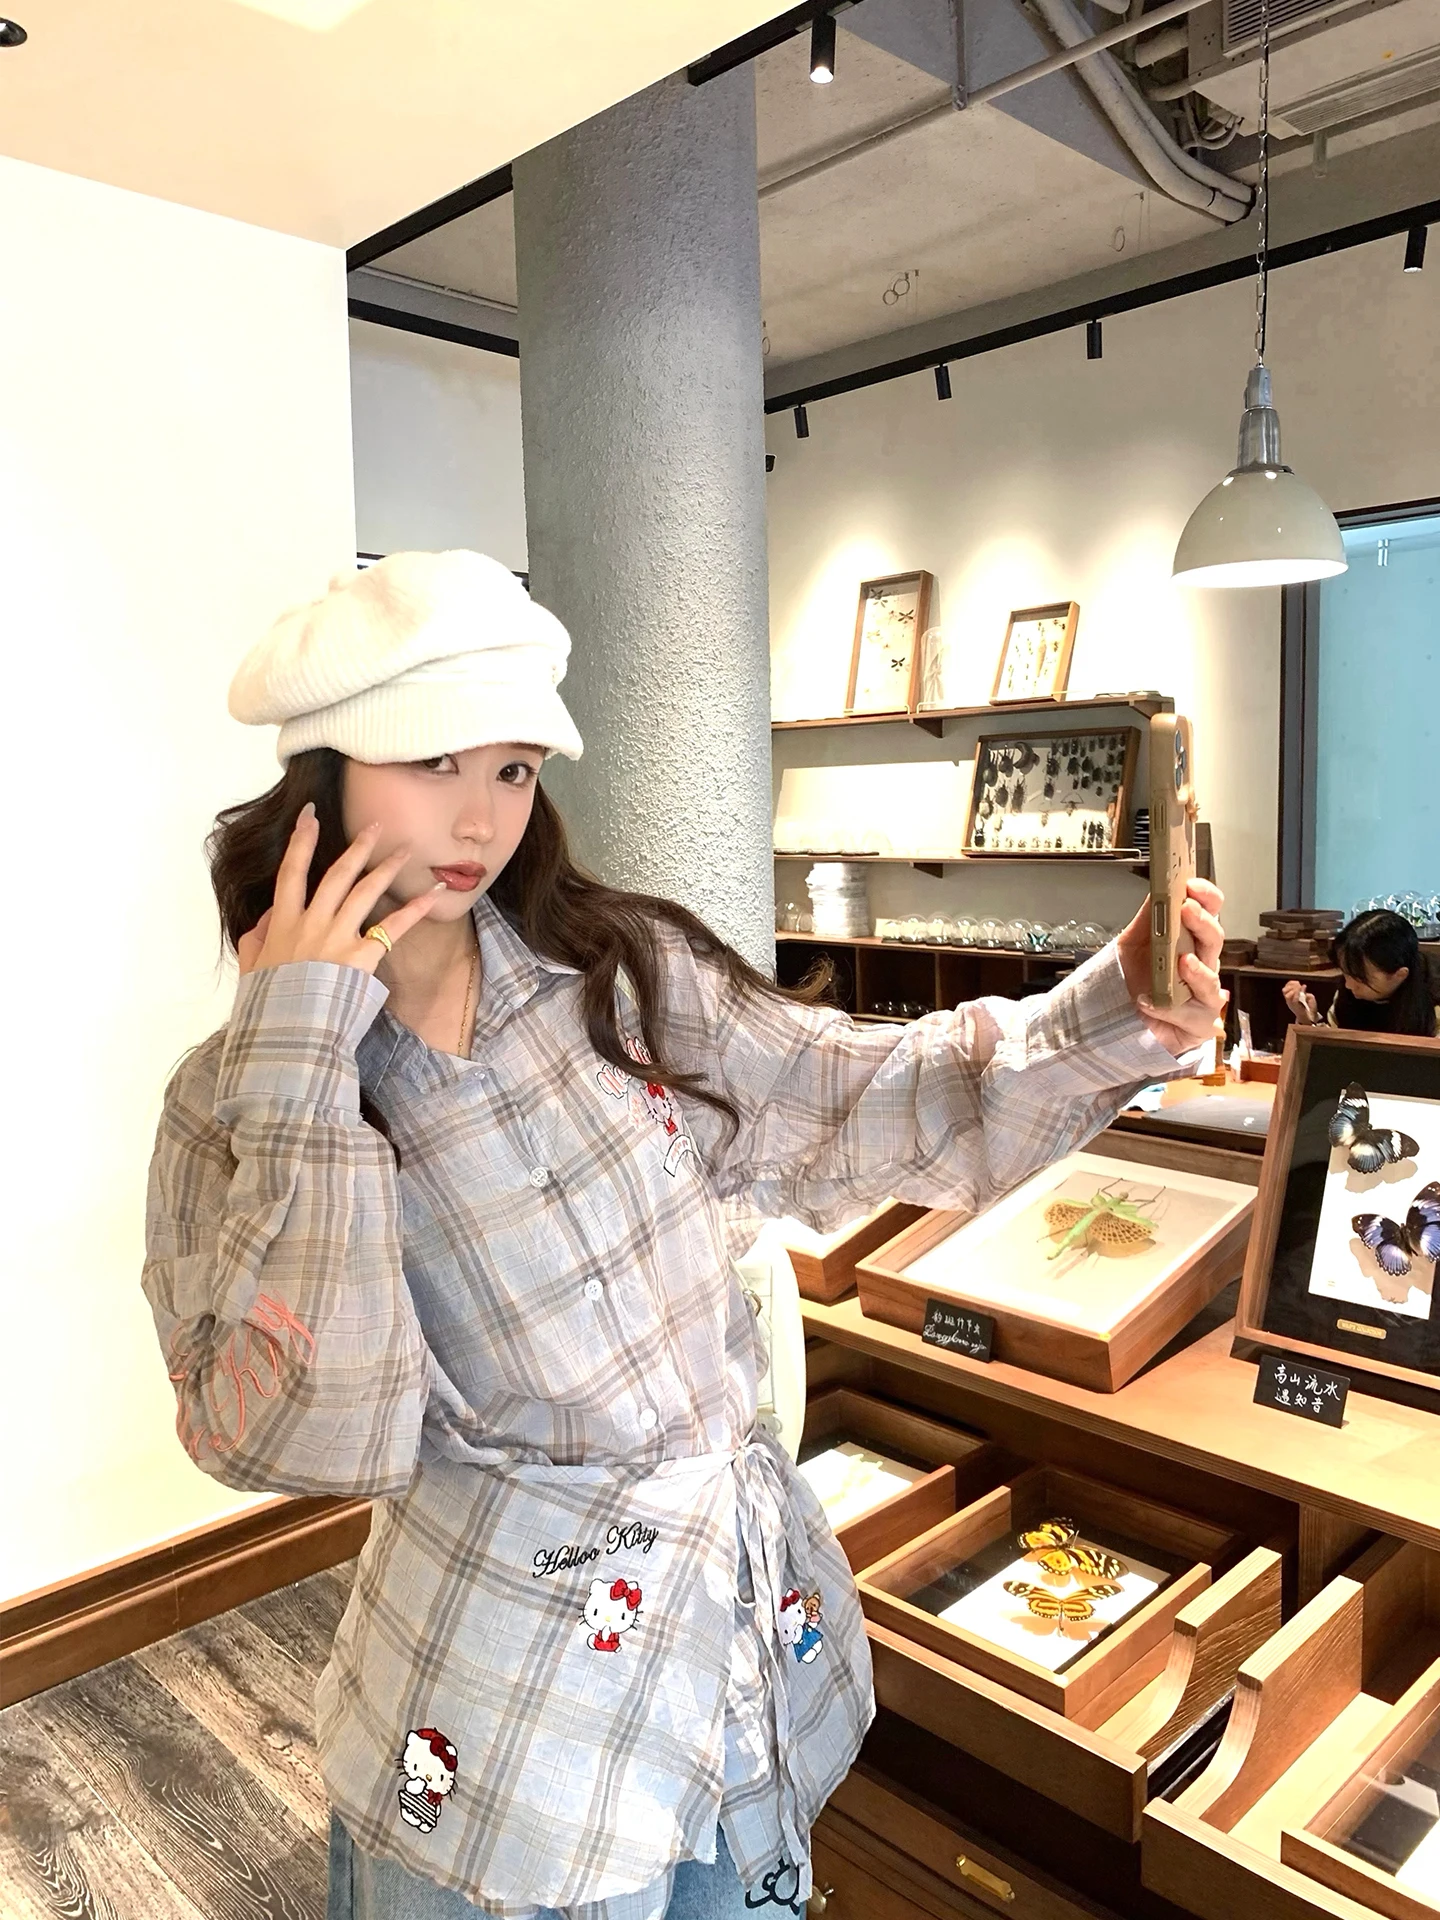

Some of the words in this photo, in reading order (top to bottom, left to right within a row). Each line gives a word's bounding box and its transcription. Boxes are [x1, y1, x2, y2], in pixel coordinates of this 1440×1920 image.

[1274, 1363, 1341, 1401] 高山流水
[1274, 1387, 1324, 1414] 遇知音
[532, 1545, 600, 1578] Helloo
[606, 1521, 659, 1554] Kitty
